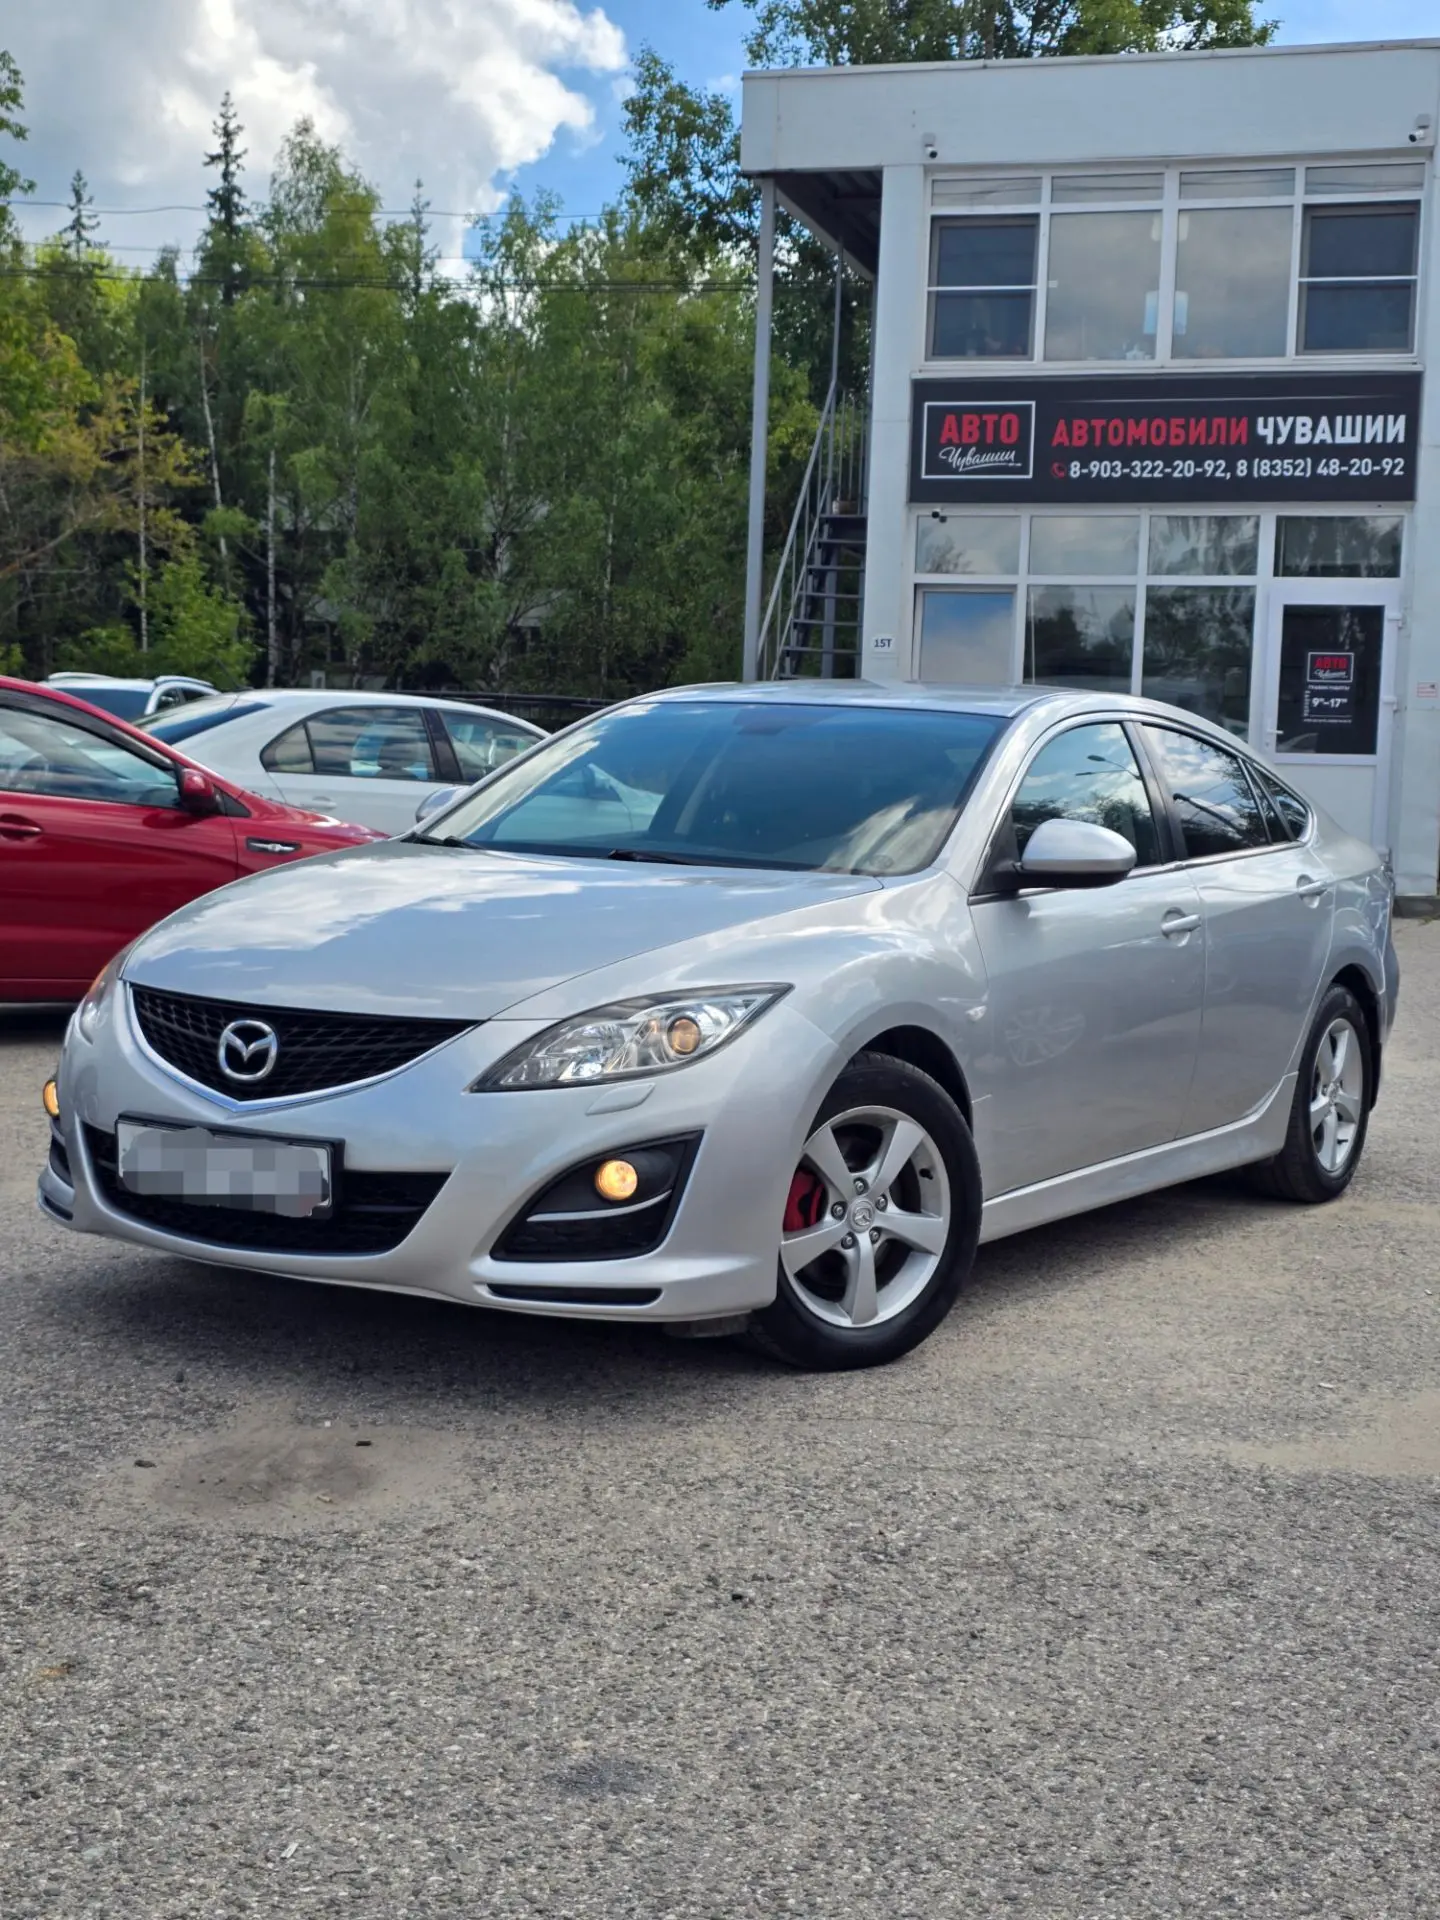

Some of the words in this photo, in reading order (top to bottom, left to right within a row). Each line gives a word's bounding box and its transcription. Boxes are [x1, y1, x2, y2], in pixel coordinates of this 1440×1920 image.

[939, 413, 1019, 444] АВТО
[1052, 418, 1248, 447] АВТОМОБИЛИ
[1256, 414, 1406, 445] ЧУВАШИИ
[939, 446, 1017, 472] Чувашии
[1069, 460, 1231, 480] 8-903-322-20-92,
[1236, 459, 1248, 477] 8
[1252, 457, 1311, 478] (8352)
[1316, 457, 1405, 477] 48-20-92
